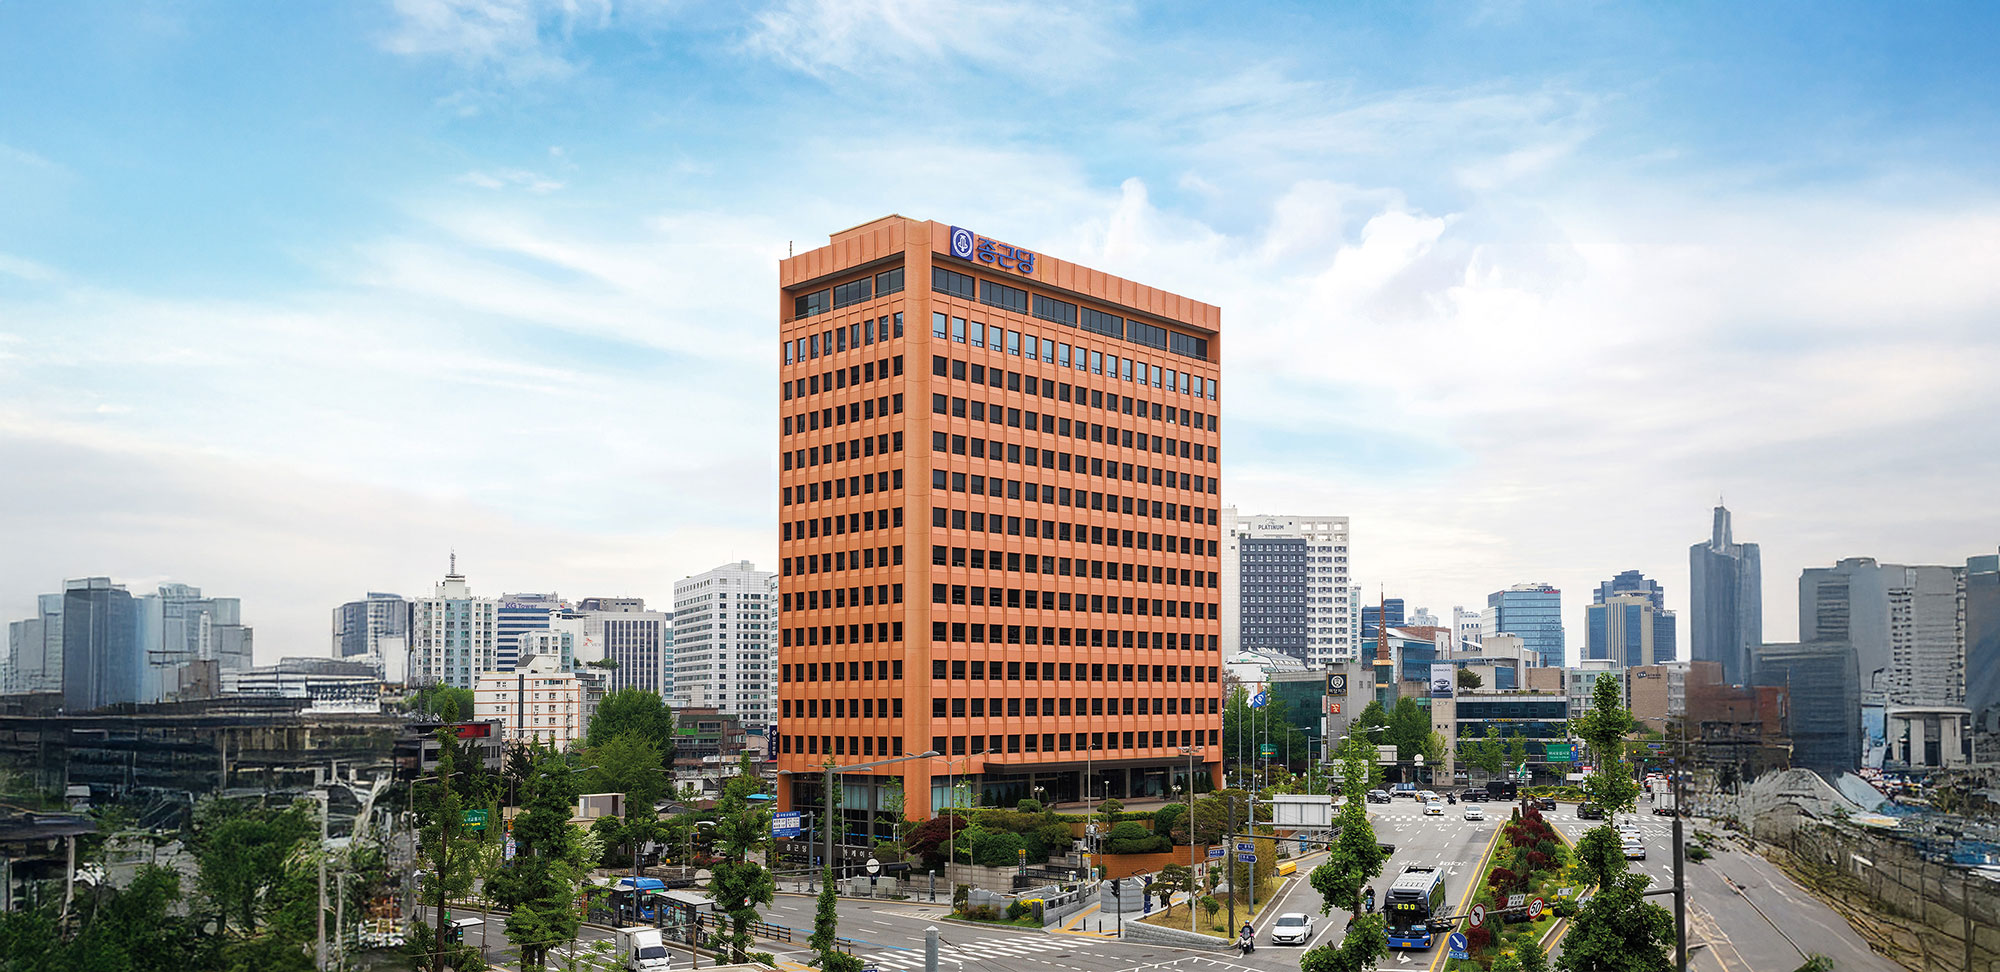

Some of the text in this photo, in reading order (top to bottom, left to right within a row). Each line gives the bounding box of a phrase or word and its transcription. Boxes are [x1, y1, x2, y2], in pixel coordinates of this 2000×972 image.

[976, 236, 1036, 274] 종근당
[505, 601, 517, 609] KG
[786, 843, 807, 853] 종근당
[1530, 901, 1542, 914] 50
